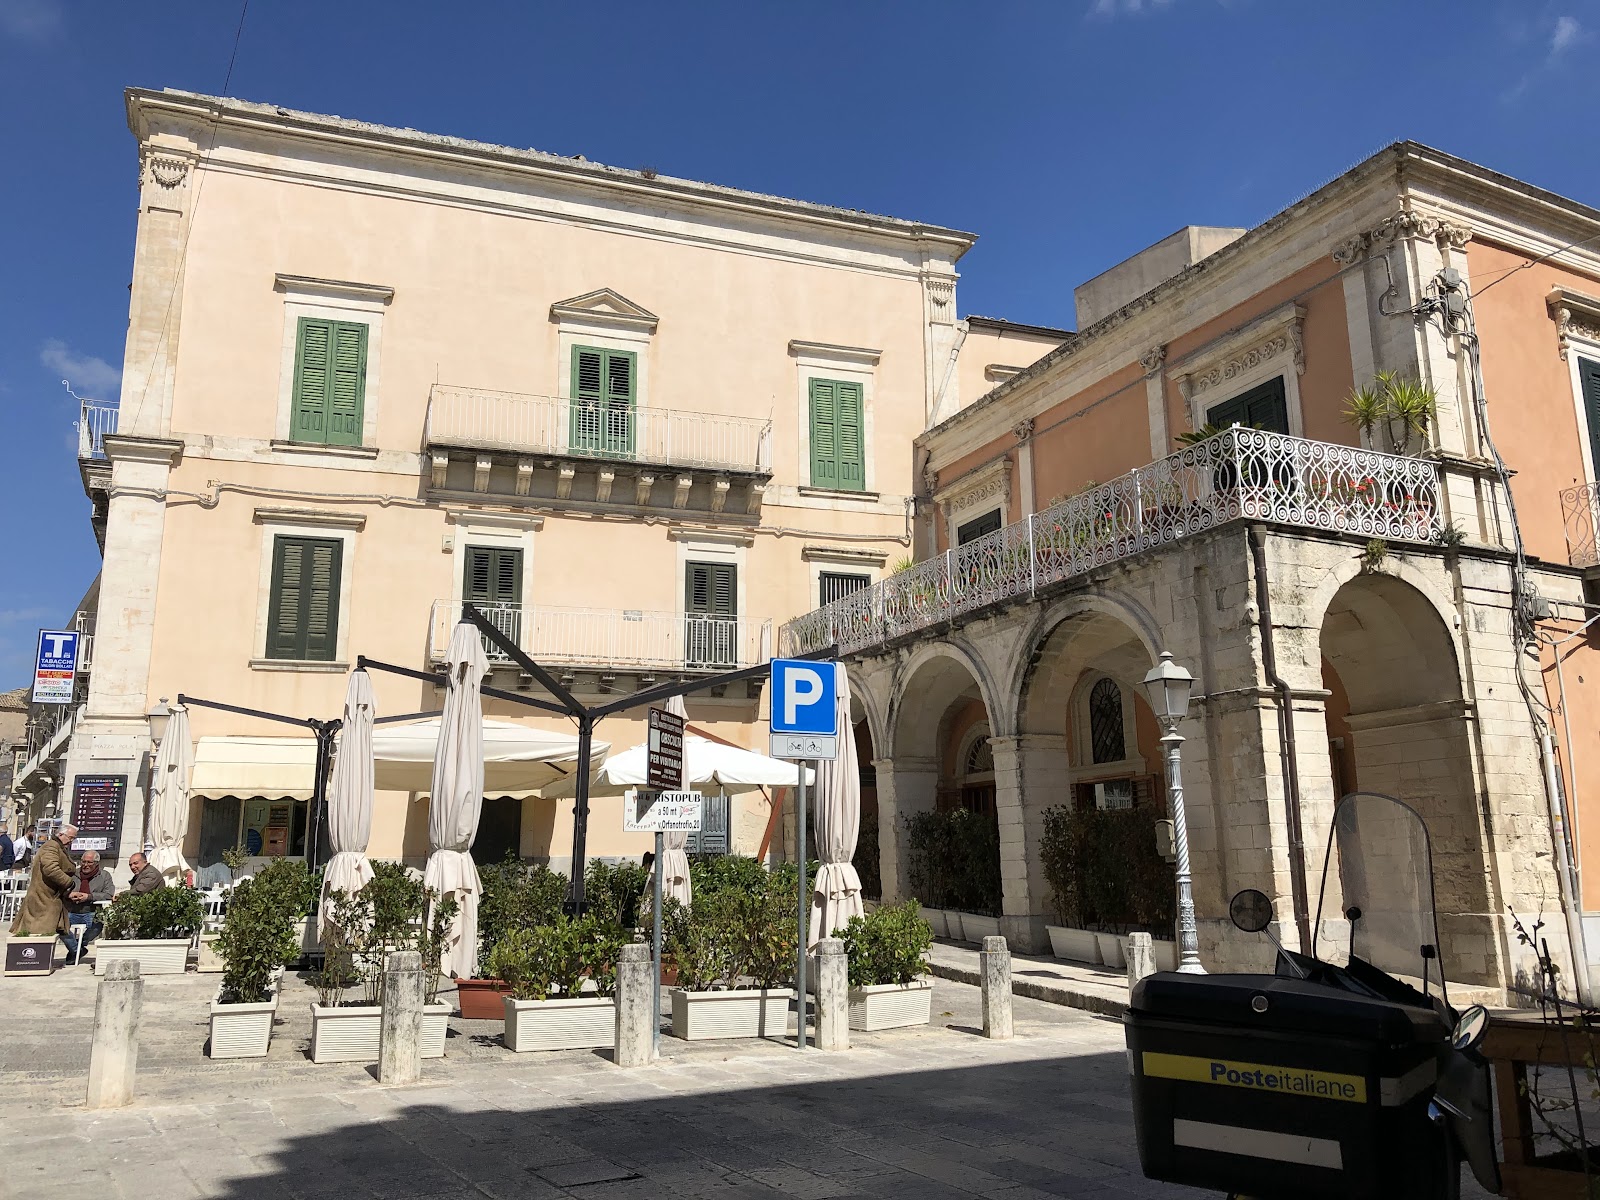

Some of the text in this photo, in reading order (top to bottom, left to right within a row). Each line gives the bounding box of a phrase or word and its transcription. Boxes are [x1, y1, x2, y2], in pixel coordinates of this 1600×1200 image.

[45, 634, 73, 658] T
[784, 667, 824, 724] P
[650, 754, 681, 770] PER VISITARLO
[654, 794, 700, 802] RISTOPUB
[663, 807, 669, 815] 50
[670, 807, 677, 815] mt
[1210, 1062, 1356, 1098] Posteitaliane
